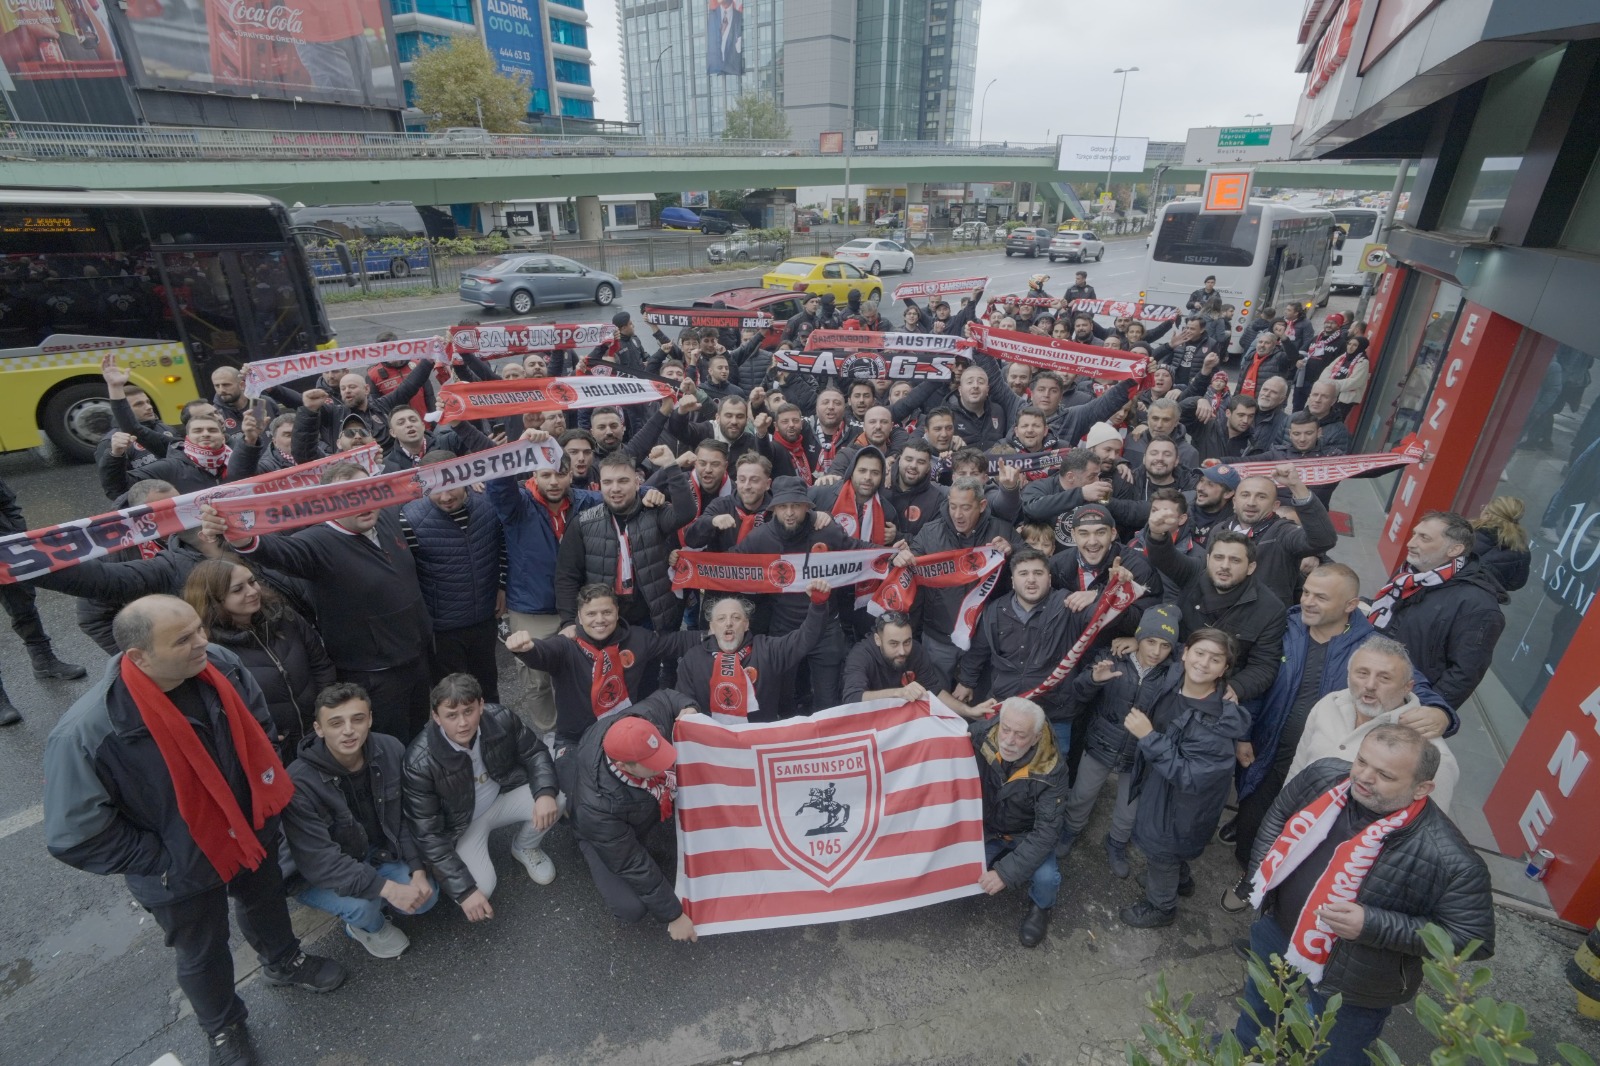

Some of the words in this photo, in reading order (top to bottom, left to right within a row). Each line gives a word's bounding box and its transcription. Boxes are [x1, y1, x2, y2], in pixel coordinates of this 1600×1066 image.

[228, 0, 304, 33] Coca-Cola
[487, 0, 532, 21] ALDIRIR.
[488, 16, 513, 33] OTO
[515, 21, 534, 37] DA.
[1213, 178, 1240, 205] E
[691, 316, 739, 327] SAMSUNSPOR
[479, 327, 599, 348] SAMSUNSPOR
[895, 335, 956, 349] AUSTRIA
[42, 344, 75, 353] COBRA
[990, 338, 1122, 369] www.samsunspor.biz
[129, 358, 157, 370] C-138
[265, 340, 428, 379] SAMSUNSPOR
[469, 389, 545, 407] SAMSUNSPOR
[581, 382, 646, 399] HOLLANDA
[265, 484, 396, 525] SAMSUNSPOR
[440, 447, 539, 487] AUSTRIA
[696, 563, 764, 582] SAMSUNSPOR
[802, 561, 863, 581] HOLLANDA
[776, 756, 864, 776] SAMSUNSPOR
[808, 838, 842, 857] 1965
